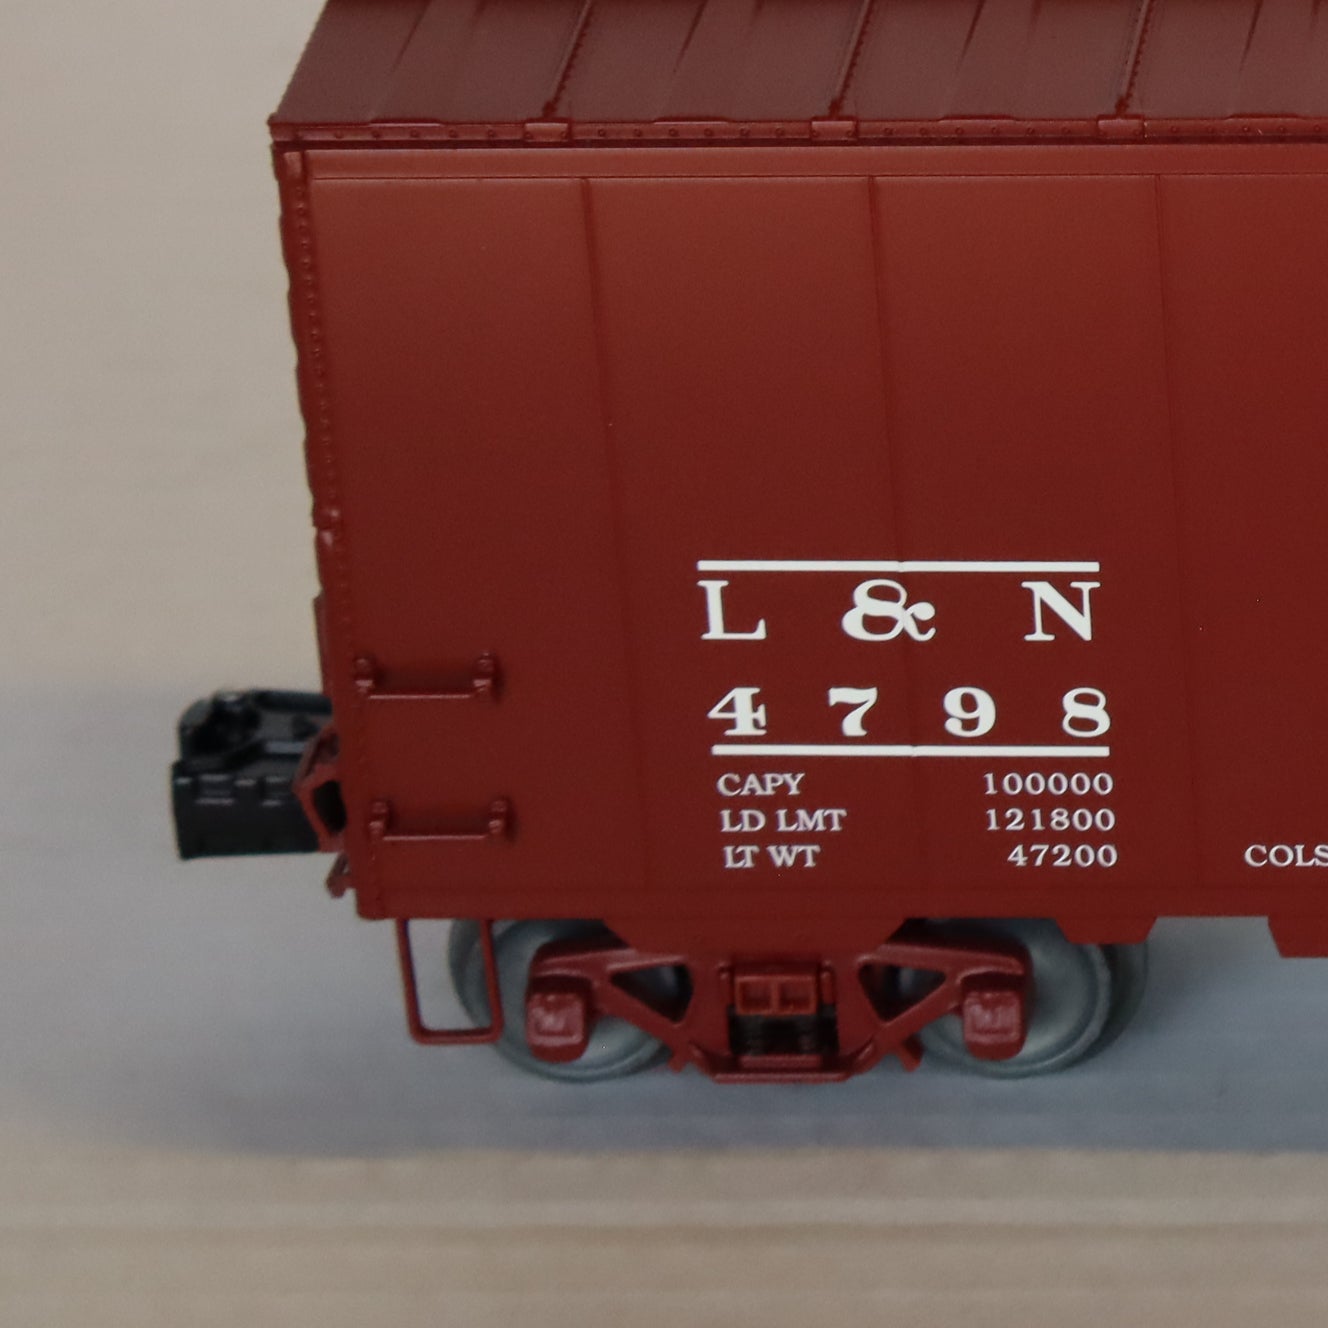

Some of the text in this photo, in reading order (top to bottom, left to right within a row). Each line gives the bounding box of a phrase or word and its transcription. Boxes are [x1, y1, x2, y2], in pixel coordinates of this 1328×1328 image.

[697, 579, 1100, 641] L & N
[717, 773, 1113, 796] CAPY 100000
[720, 808, 1115, 832] LD LMT 121800
[724, 844, 1117, 868] LT WT 47200
